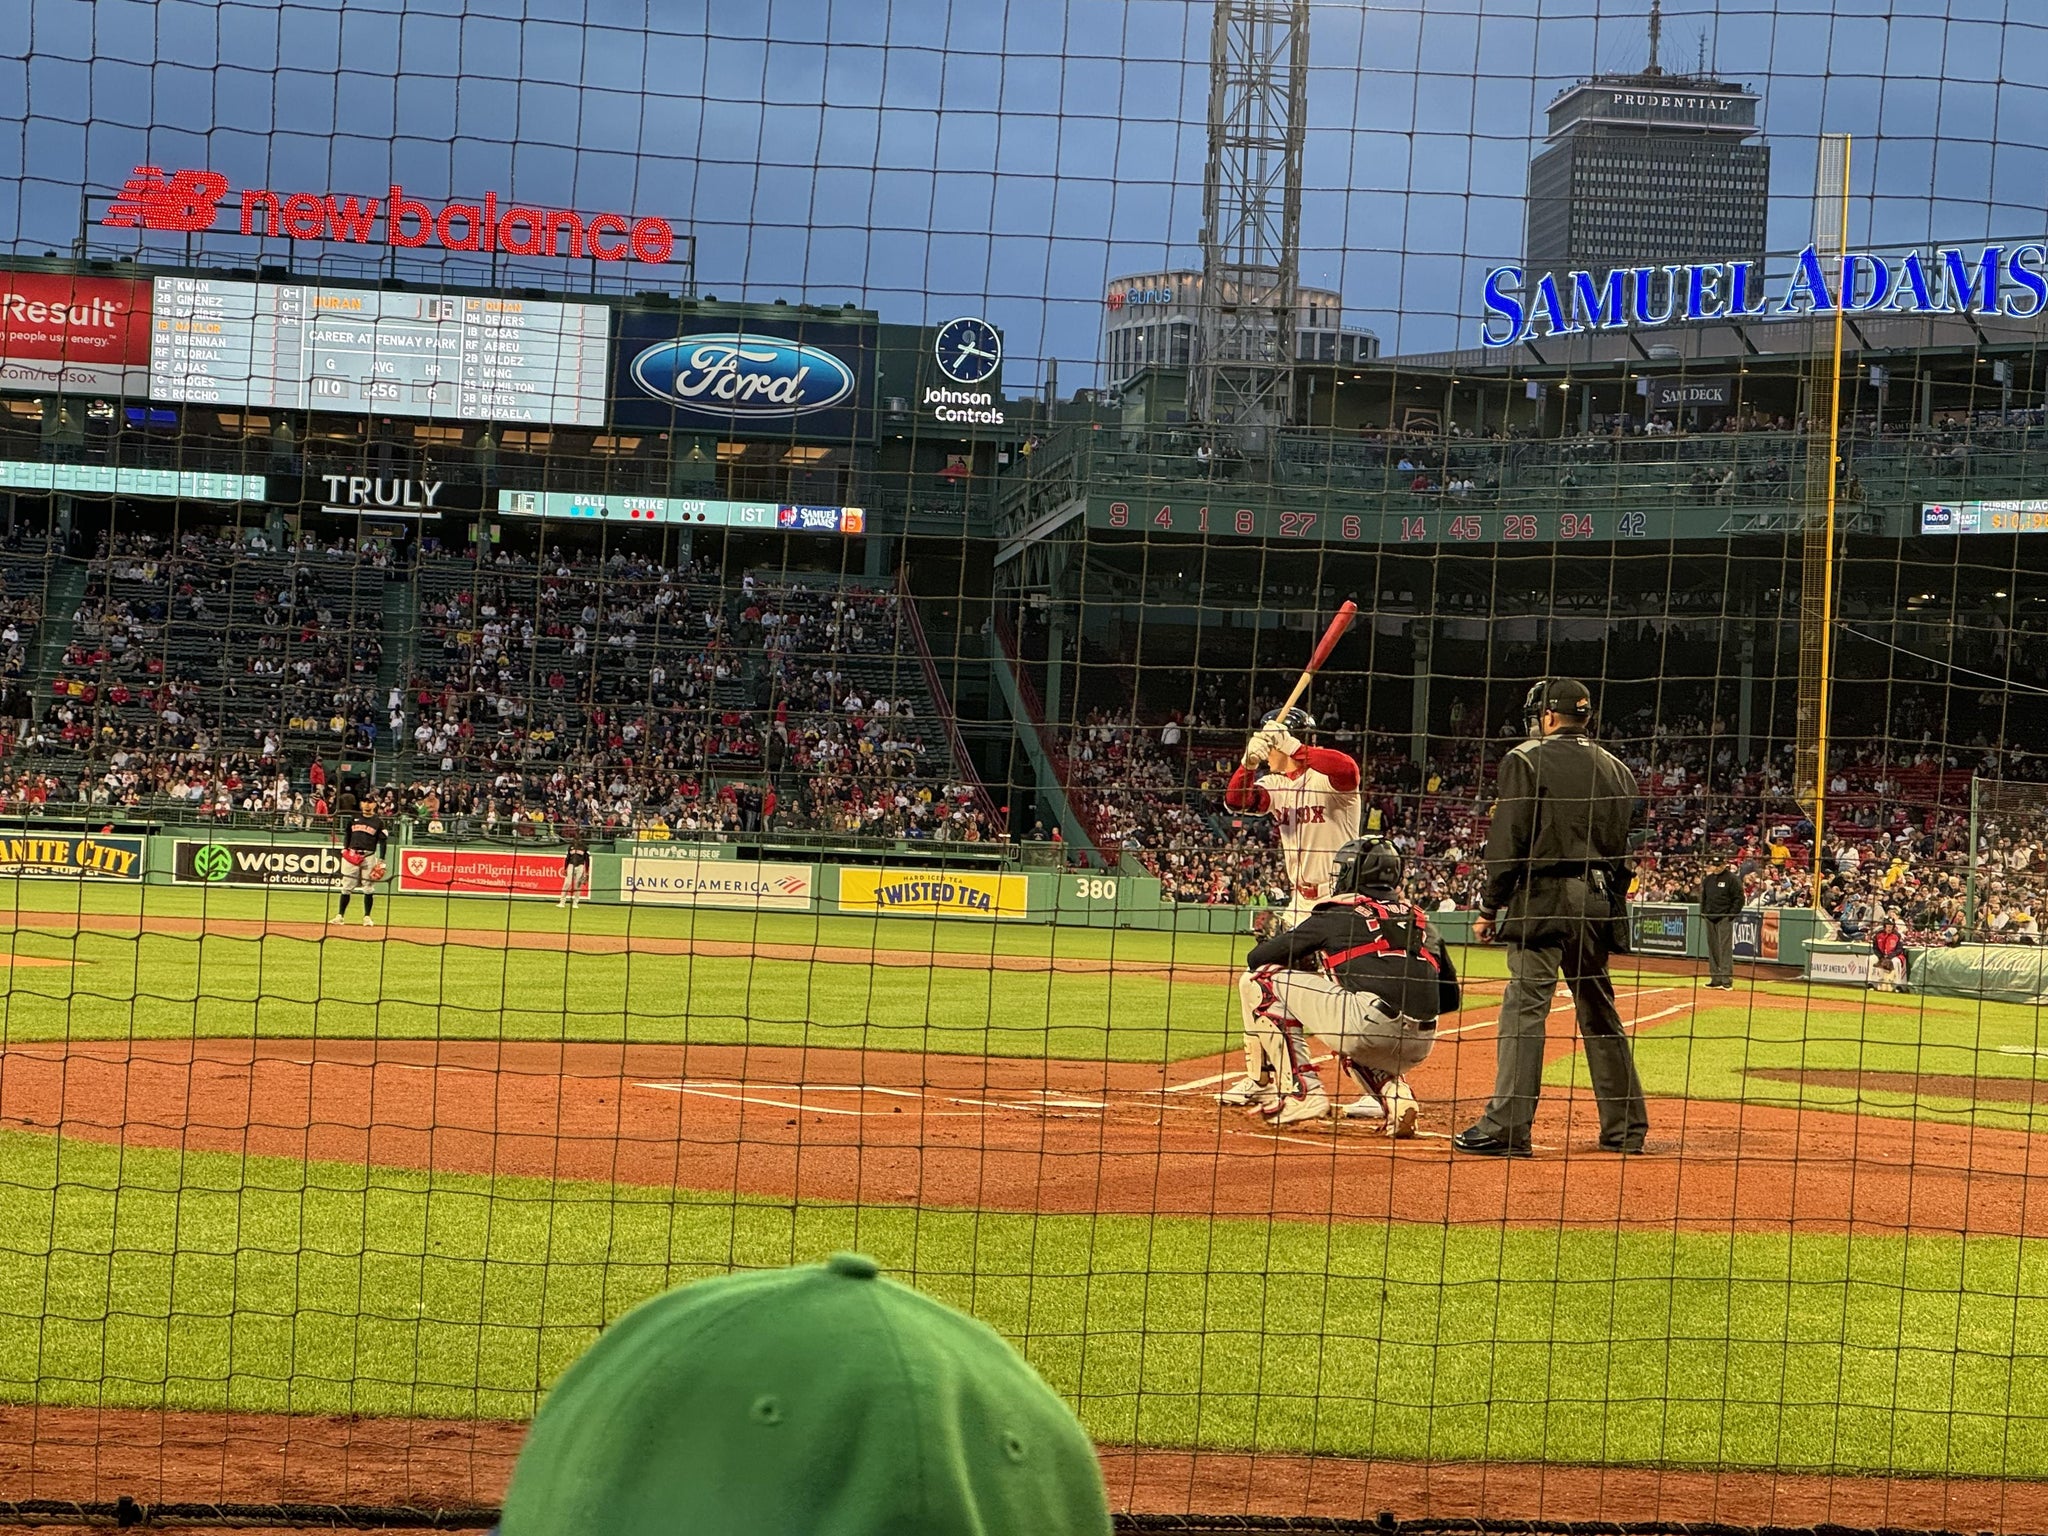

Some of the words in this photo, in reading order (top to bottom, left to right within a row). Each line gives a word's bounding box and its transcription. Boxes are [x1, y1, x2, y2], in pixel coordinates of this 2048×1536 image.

[1614, 93, 1730, 110] PRUDENTIAL
[158, 280, 171, 290] LF
[177, 281, 208, 292] KWAN
[157, 294, 171, 303] 2B
[1481, 261, 1767, 348] SAMUEL
[1777, 243, 2048, 318] ADAMS
[2, 293, 116, 328] Result
[313, 296, 361, 311] DURAN
[467, 300, 480, 310] LF
[486, 301, 522, 312] DURAN
[157, 307, 171, 316] 3B
[466, 314, 480, 324] DH
[485, 315, 525, 326] DEVERS
[10, 331, 47, 344] people
[49, 335, 68, 343] use
[155, 334, 169, 344] DH
[175, 335, 226, 347] BRENNAN
[309, 331, 354, 343] CAREER
[357, 333, 373, 343] AT
[377, 335, 422, 347] FENWAY
[426, 338, 456, 350] PARK
[485, 328, 519, 339] CASAS
[465, 340, 478, 350] RF
[155, 347, 169, 357] RF
[174, 349, 221, 360] FLORIAL
[464, 354, 478, 363] 2B
[484, 355, 524, 366] VALDEZ
[154, 361, 169, 370] CF
[326, 358, 336, 370] G
[371, 362, 394, 373] AVG
[425, 364, 441, 376] HR
[467, 367, 474, 376] C
[483, 367, 512, 379] WONG
[156, 375, 164, 384] C
[676, 345, 810, 403] Ford
[464, 380, 476, 390] SS
[153, 388, 167, 398] SS
[172, 389, 219, 400] ROCCHIO
[427, 386, 437, 400] 6
[463, 394, 476, 403] 3B
[481, 394, 515, 405] REYES
[923, 387, 991, 405] Johnson
[1661, 388, 1687, 404] SAM
[1690, 388, 1723, 401] DECK
[463, 407, 476, 416] CF
[481, 408, 531, 420] RAFAELA
[935, 405, 1004, 425] Controls
[322, 474, 442, 507] TRULY
[574, 495, 606, 507] BALL
[623, 498, 664, 510] STRIKE
[682, 501, 706, 512] OUT
[1982, 501, 2026, 511] CURRENT
[800, 508, 838, 521] SAMUEL
[1109, 502, 1129, 527] 9
[1154, 505, 1172, 529] 4
[1199, 507, 1209, 532] 1
[803, 517, 836, 529] ADAMS
[1235, 510, 1254, 535] 8
[1279, 512, 1316, 537] 27
[1341, 515, 1361, 540] 6
[1401, 516, 1426, 541] 14
[1449, 516, 1481, 541] 45
[1503, 514, 1538, 540] 26
[1559, 513, 1593, 539] 34
[1618, 511, 1646, 537] 42
[689, 849, 710, 858] HOUSE
[711, 850, 720, 858] OF
[236, 849, 345, 874] wasab
[430, 862, 476, 874] Harvard
[477, 864, 517, 878] Pilgrim
[520, 865, 556, 877] Health
[282, 873, 309, 884] cloud
[626, 877, 669, 889] BANK
[674, 878, 693, 889] OF
[698, 880, 770, 892] AMERICA
[1076, 878, 1117, 900] 380
[874, 882, 954, 908] TWISTED
[959, 886, 991, 913] TEA
[1829, 964, 1848, 974] AMERICA
